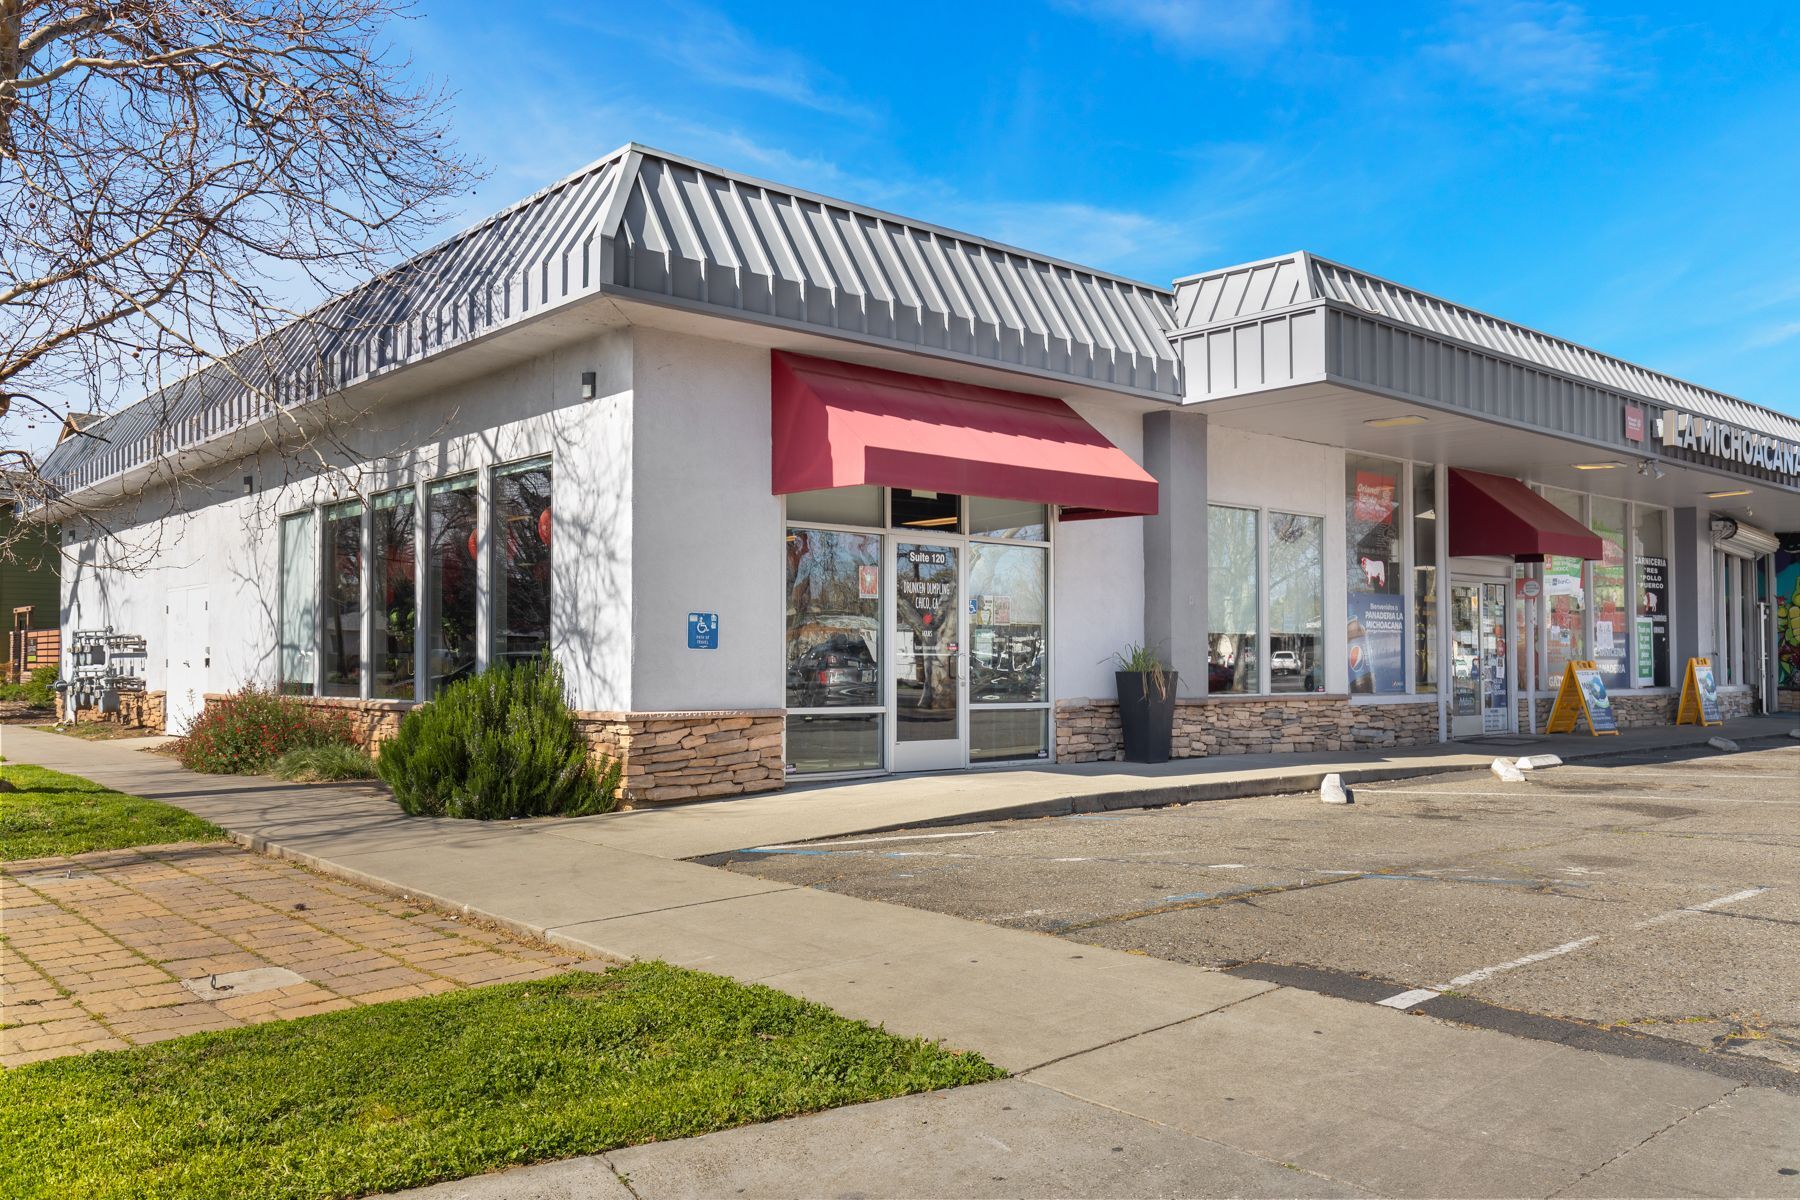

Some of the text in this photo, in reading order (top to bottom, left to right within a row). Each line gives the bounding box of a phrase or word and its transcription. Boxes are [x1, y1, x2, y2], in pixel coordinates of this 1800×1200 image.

[1669, 410, 1698, 452] LA
[909, 551, 945, 564] Suite 120
[1634, 556, 1667, 567] CARNICERIA
[903, 581, 950, 595] DRUNKEN DUMPLING
[915, 597, 939, 610] CHICO, CA
[1365, 611, 1404, 620] PANADERIA LA
[1365, 620, 1403, 630] MICHOACANA
